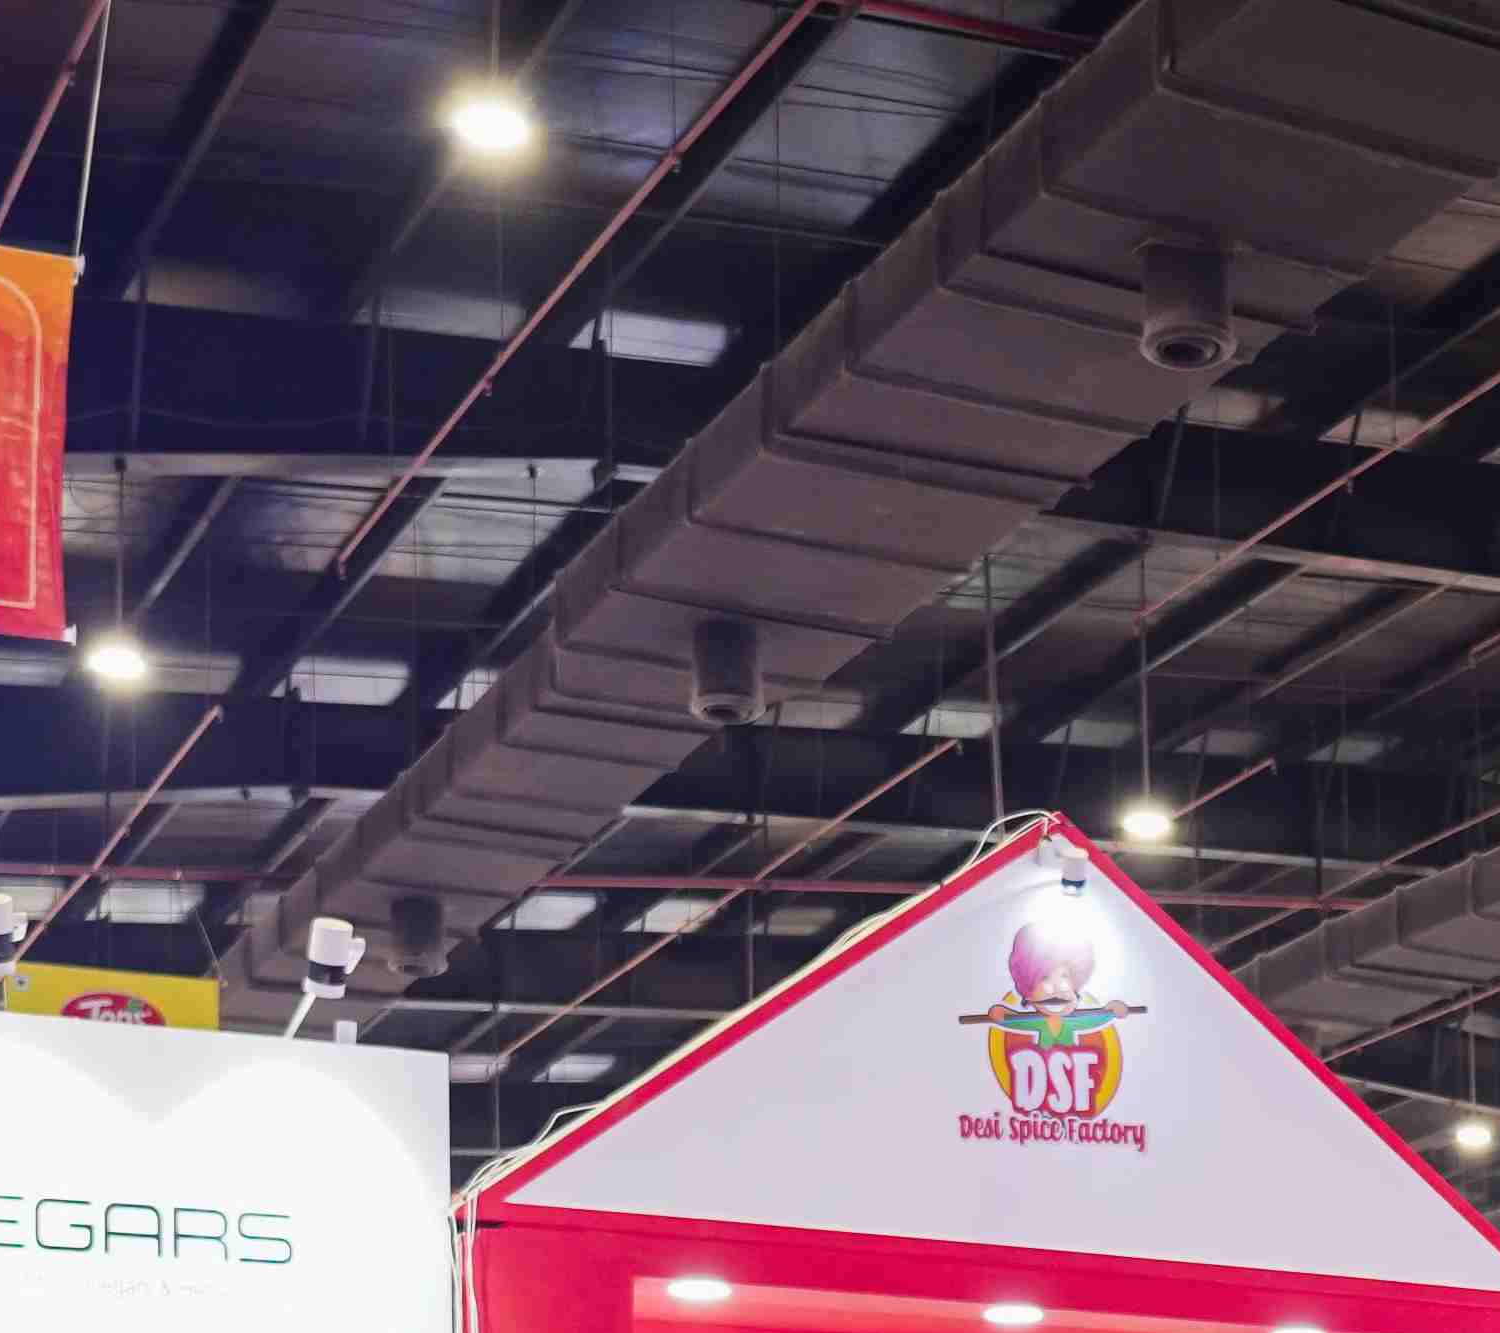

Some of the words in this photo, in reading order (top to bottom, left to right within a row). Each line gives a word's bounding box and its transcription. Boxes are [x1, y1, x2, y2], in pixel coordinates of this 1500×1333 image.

[1010, 1048, 1099, 1114] DSF
[959, 1112, 1002, 1139] Desi
[1009, 1116, 1062, 1143] Spice
[1066, 1117, 1147, 1152] Factory
